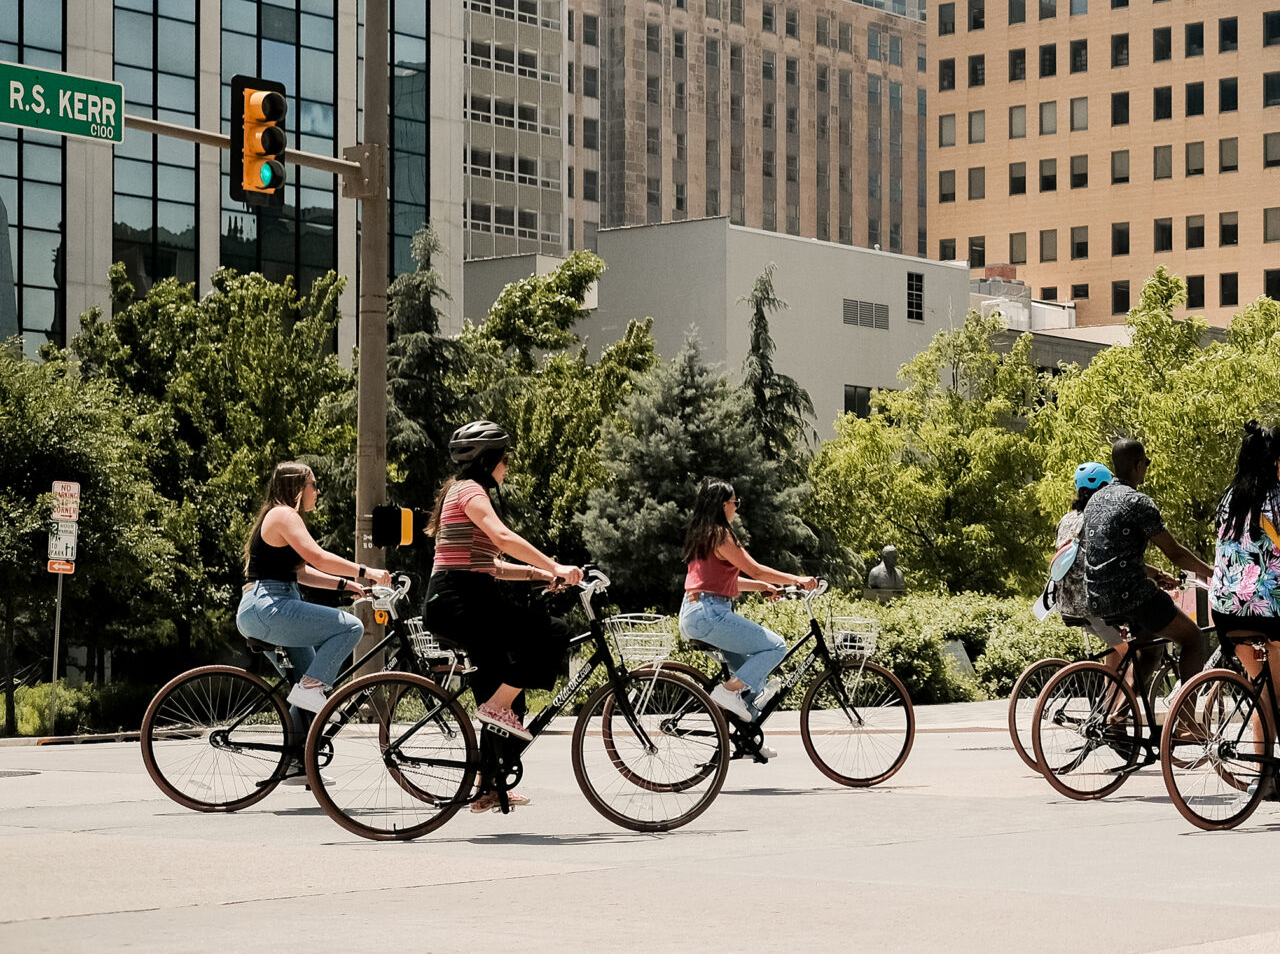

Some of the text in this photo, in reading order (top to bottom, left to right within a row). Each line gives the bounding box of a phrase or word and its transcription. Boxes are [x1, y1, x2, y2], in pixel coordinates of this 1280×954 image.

[9, 80, 116, 126] R.S. KERR
[61, 484, 72, 492] NO
[51, 523, 58, 534] 2
